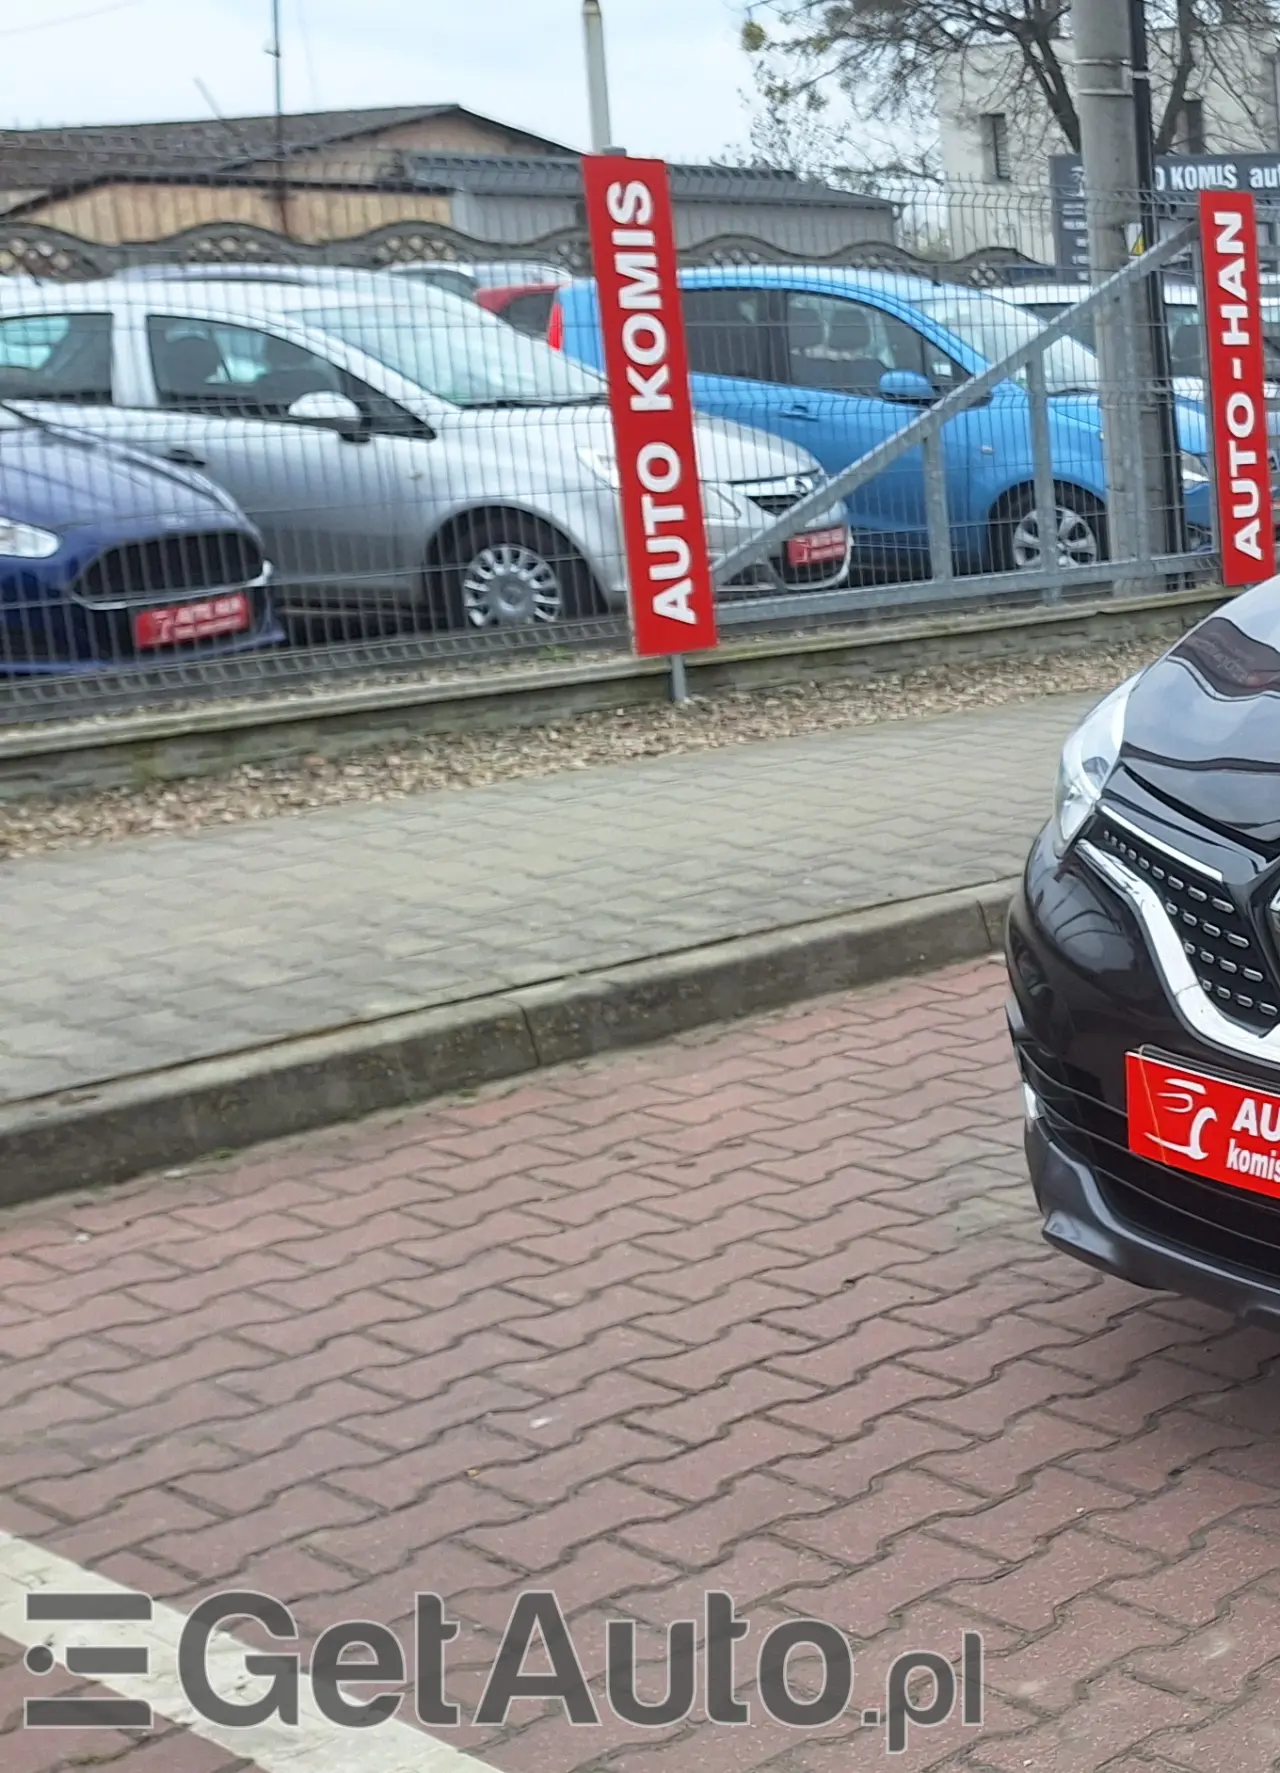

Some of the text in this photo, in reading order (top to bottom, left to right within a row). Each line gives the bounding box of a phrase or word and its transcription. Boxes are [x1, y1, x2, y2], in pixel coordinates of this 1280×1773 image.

[1170, 164, 1238, 190] KOMIS
[606, 180, 698, 626] AUTO KOMIS
